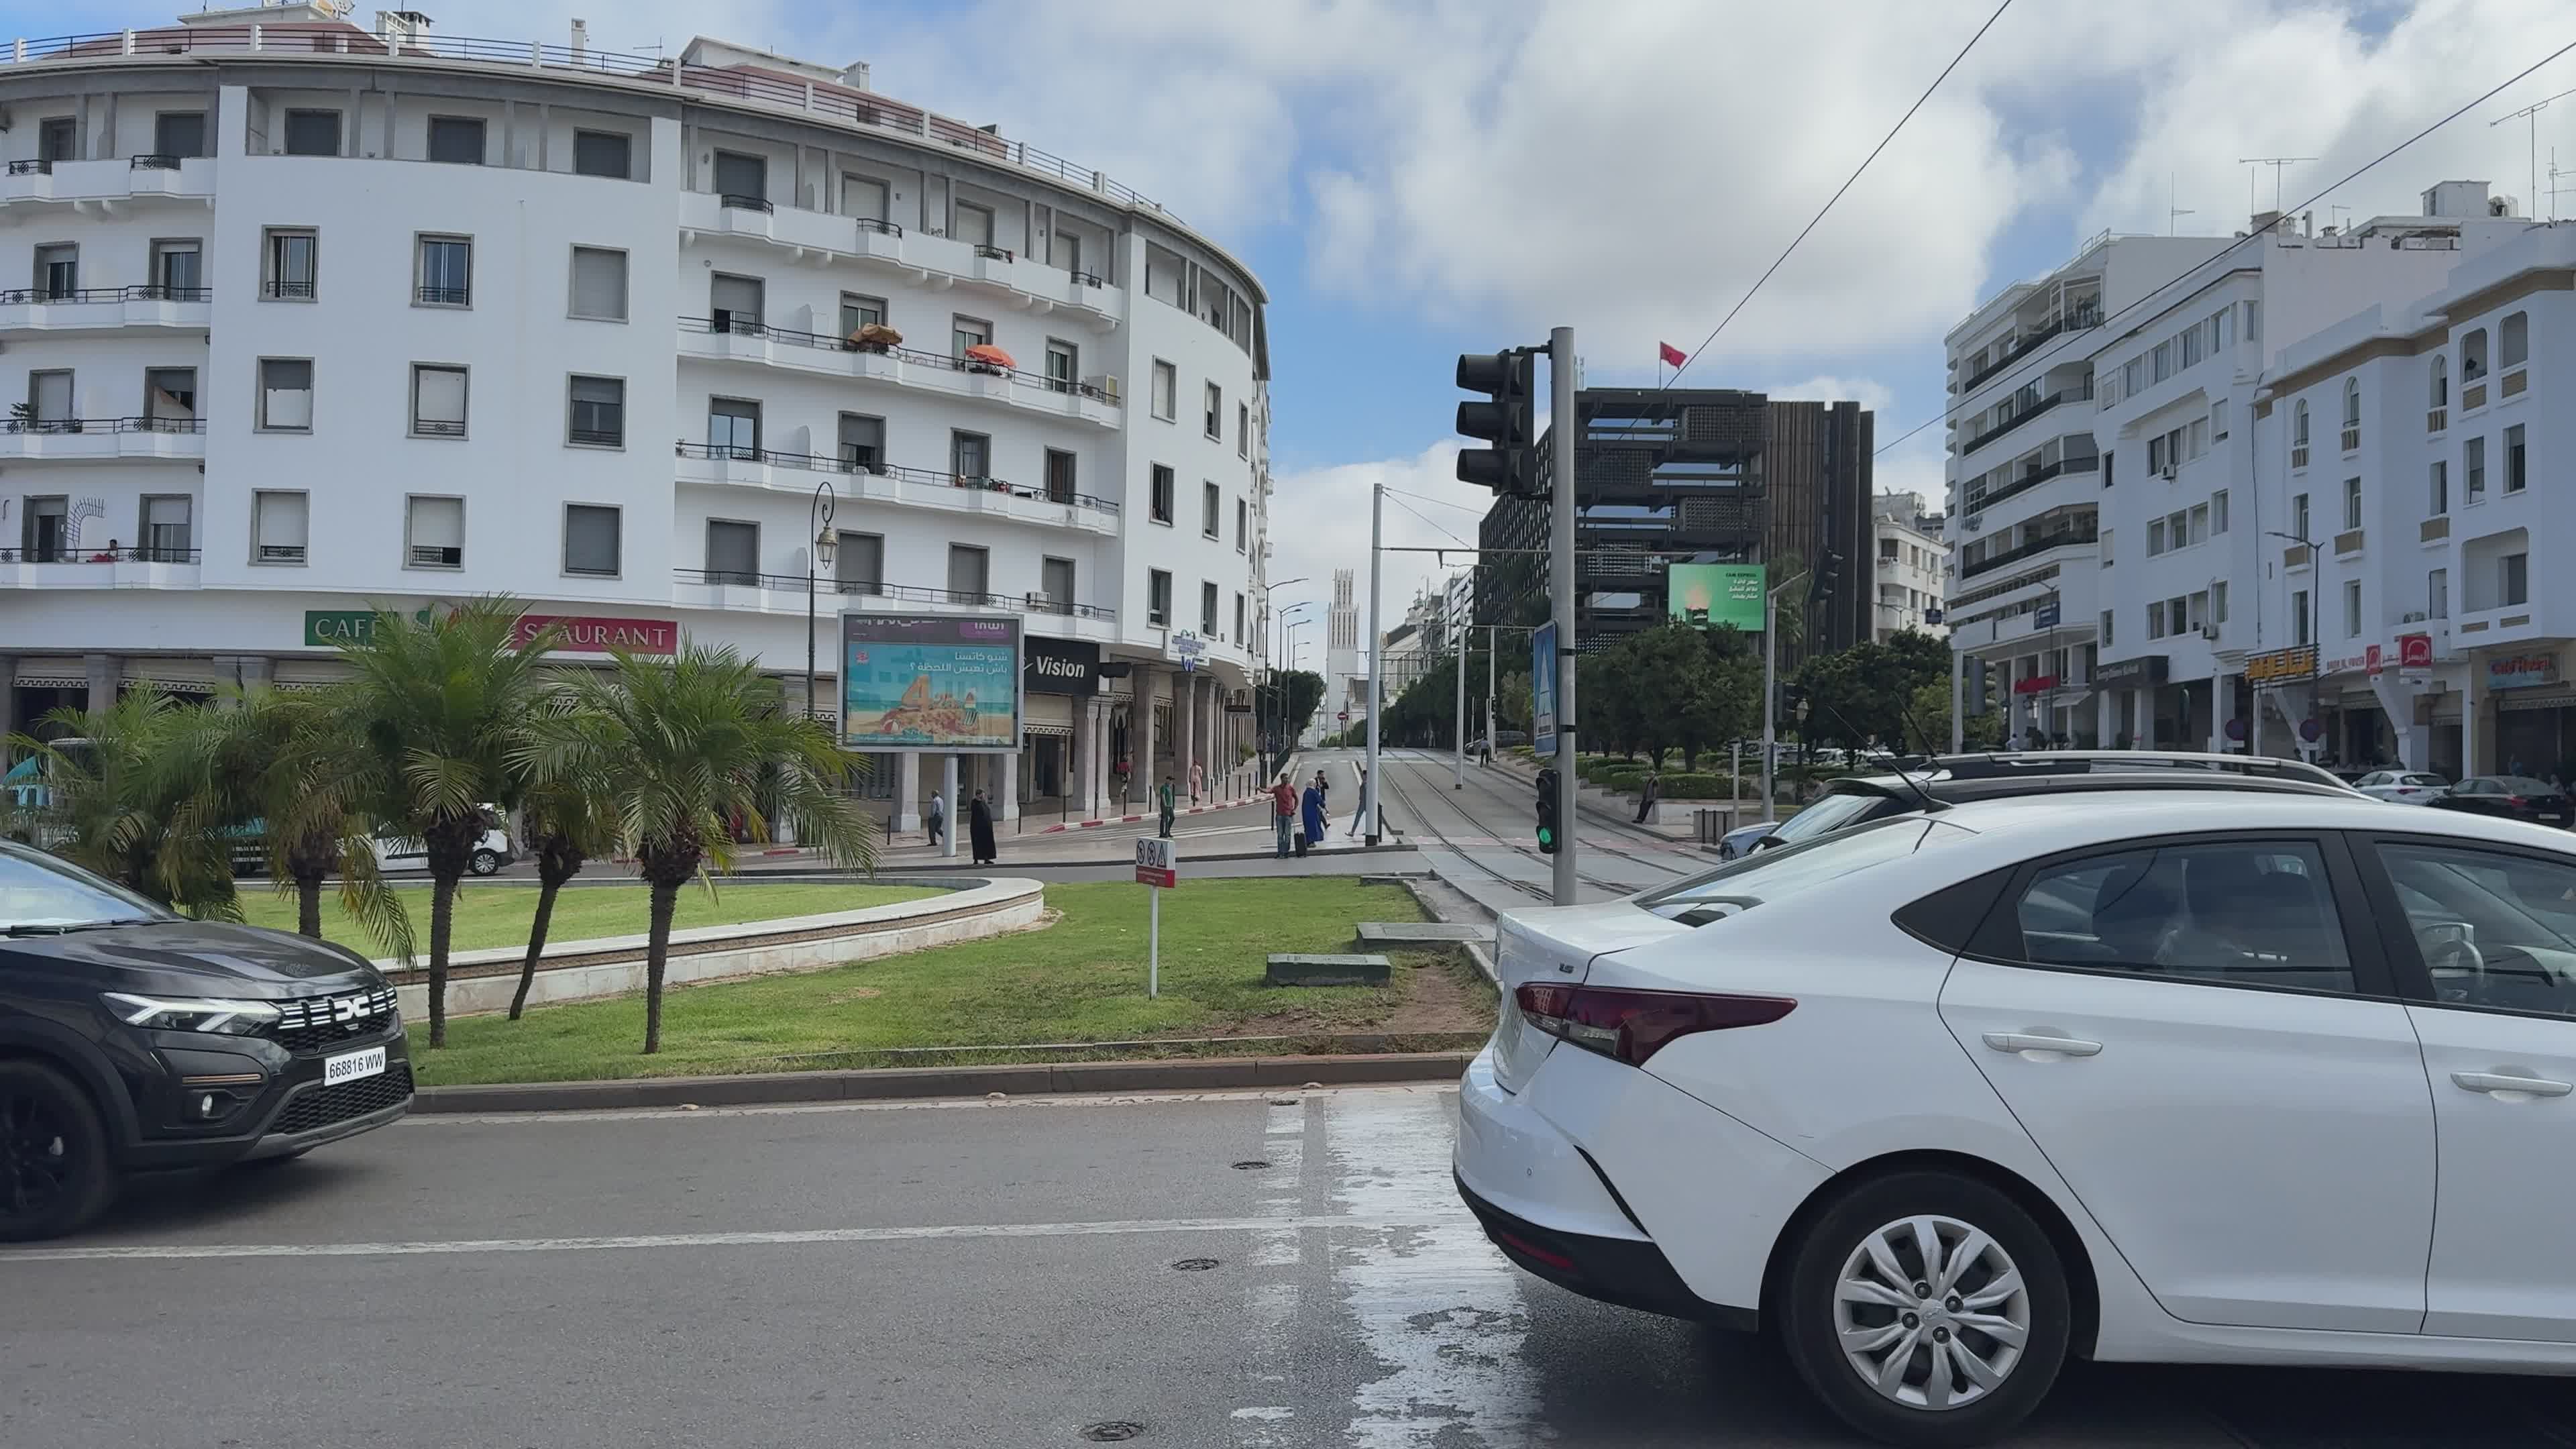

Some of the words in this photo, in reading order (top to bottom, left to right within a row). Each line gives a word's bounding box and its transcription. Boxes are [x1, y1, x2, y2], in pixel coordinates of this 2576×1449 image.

[1036, 655, 1085, 678] Vision
[329, 1057, 364, 1079] 668816
[365, 1052, 384, 1070] WW
